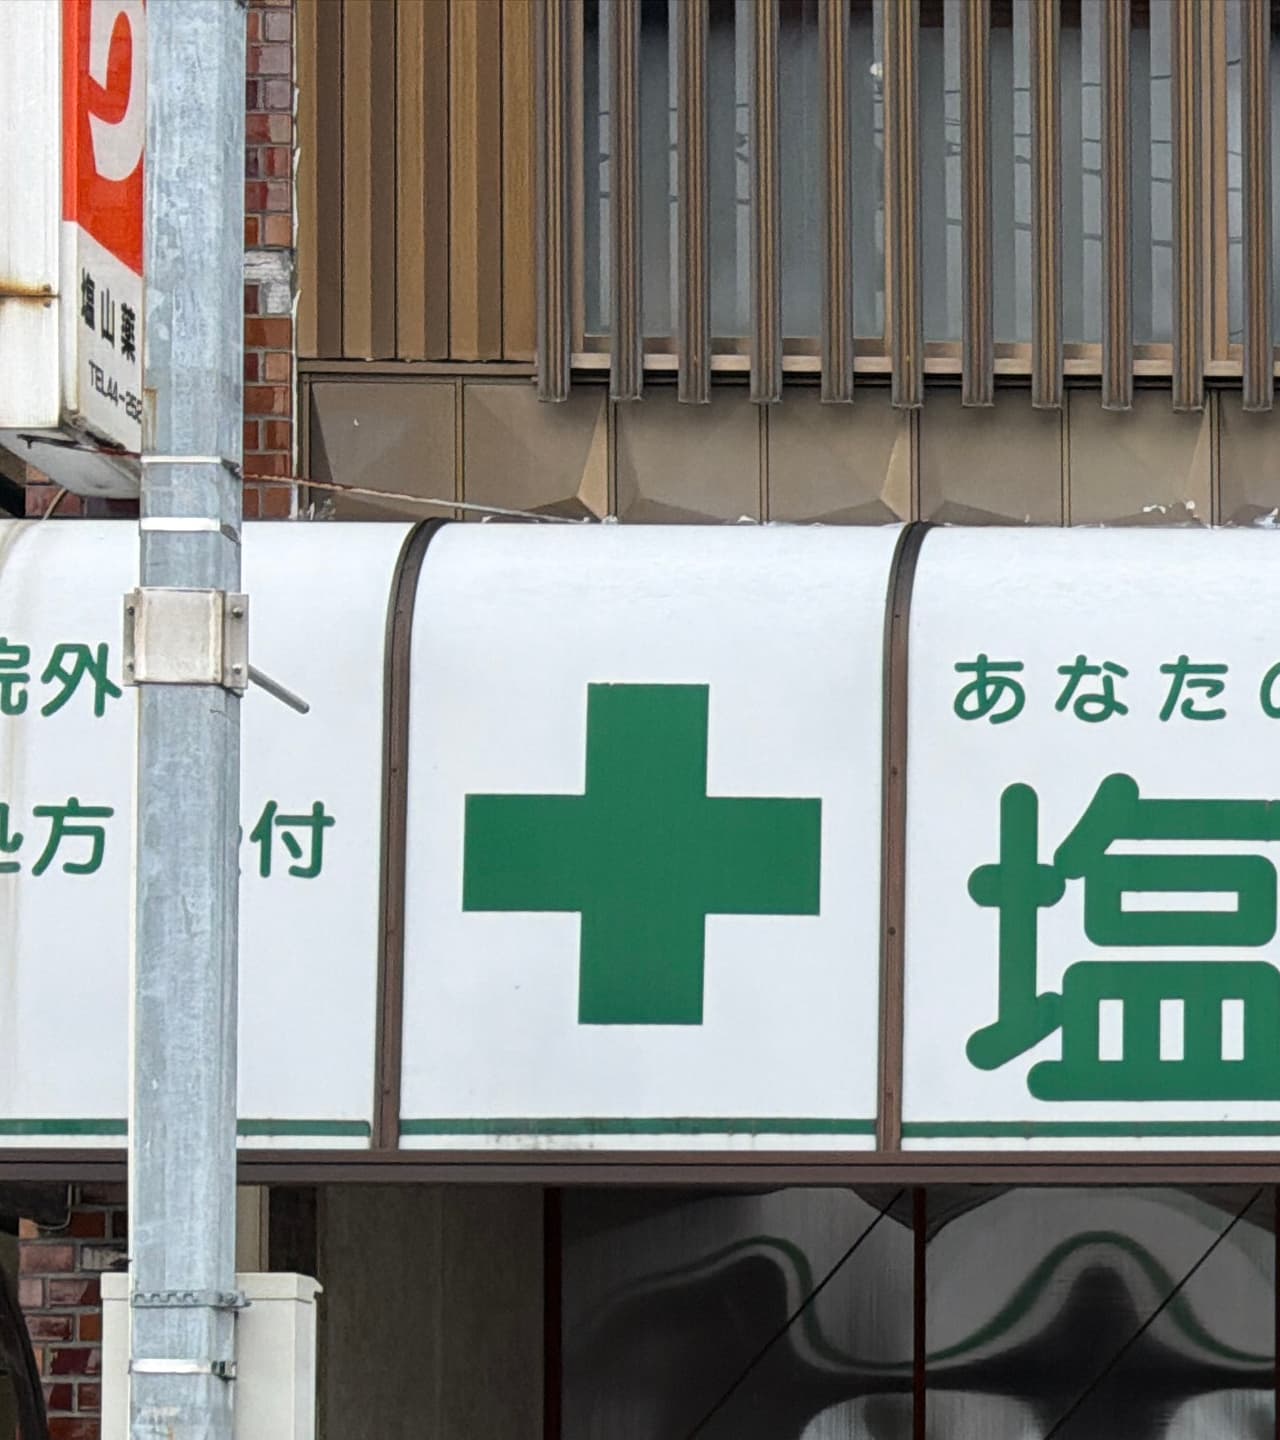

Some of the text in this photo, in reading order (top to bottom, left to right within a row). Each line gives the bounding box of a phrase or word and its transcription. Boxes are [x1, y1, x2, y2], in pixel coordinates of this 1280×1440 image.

[81, 267, 137, 364] 塩山薬
[88, 359, 143, 425] TEL44-252
